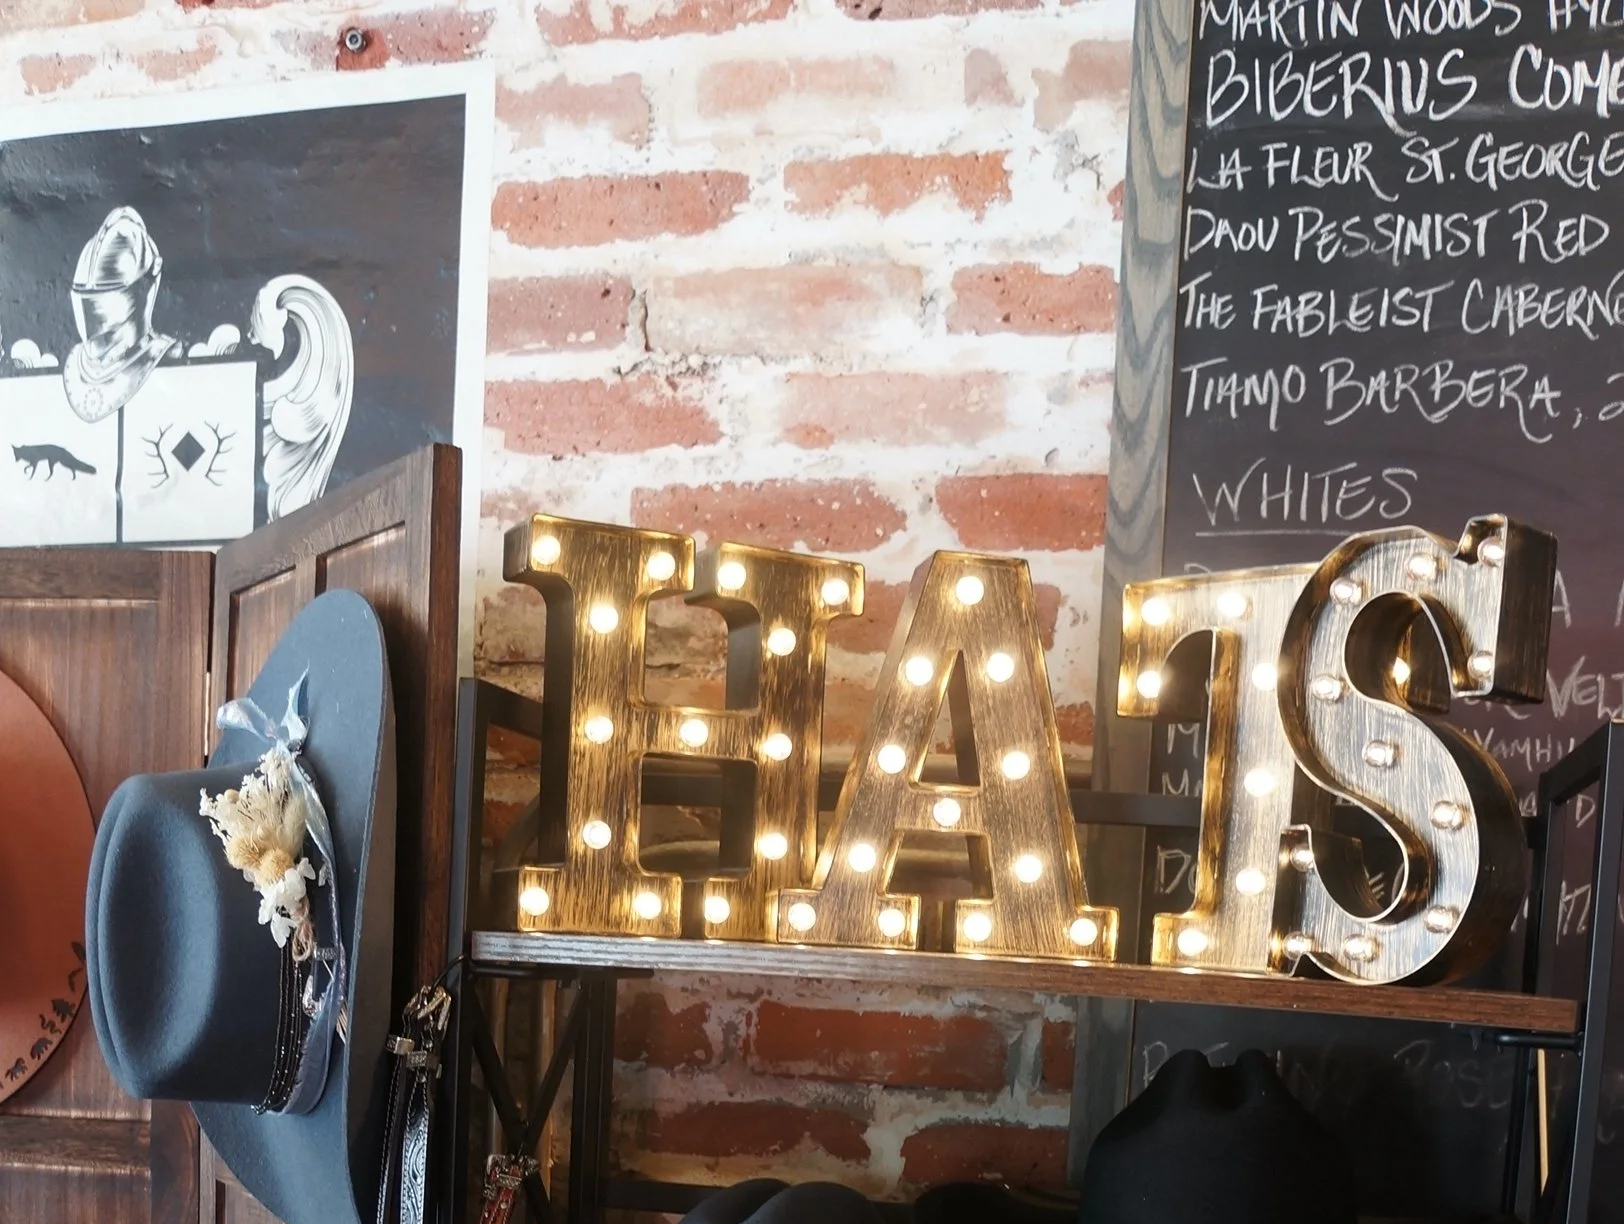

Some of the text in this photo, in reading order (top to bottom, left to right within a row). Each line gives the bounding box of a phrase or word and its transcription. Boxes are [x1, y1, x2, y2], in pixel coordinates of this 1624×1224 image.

[1198, 0, 1362, 49] MARTIN
[1384, 0, 1522, 39] WOODS
[1206, 49, 1477, 136] BIBERIUS
[1186, 131, 1624, 202] LA FLEUR ST. GEORGE
[1288, 206, 1500, 267] PESSIMIST
[1508, 199, 1610, 264] RED
[1179, 271, 1237, 330] THE
[1252, 280, 1455, 338] FABLEIST
[1180, 357, 1306, 432] TIAMO
[1192, 457, 1418, 526] WHITES
[504, 514, 1556, 988] HATS
